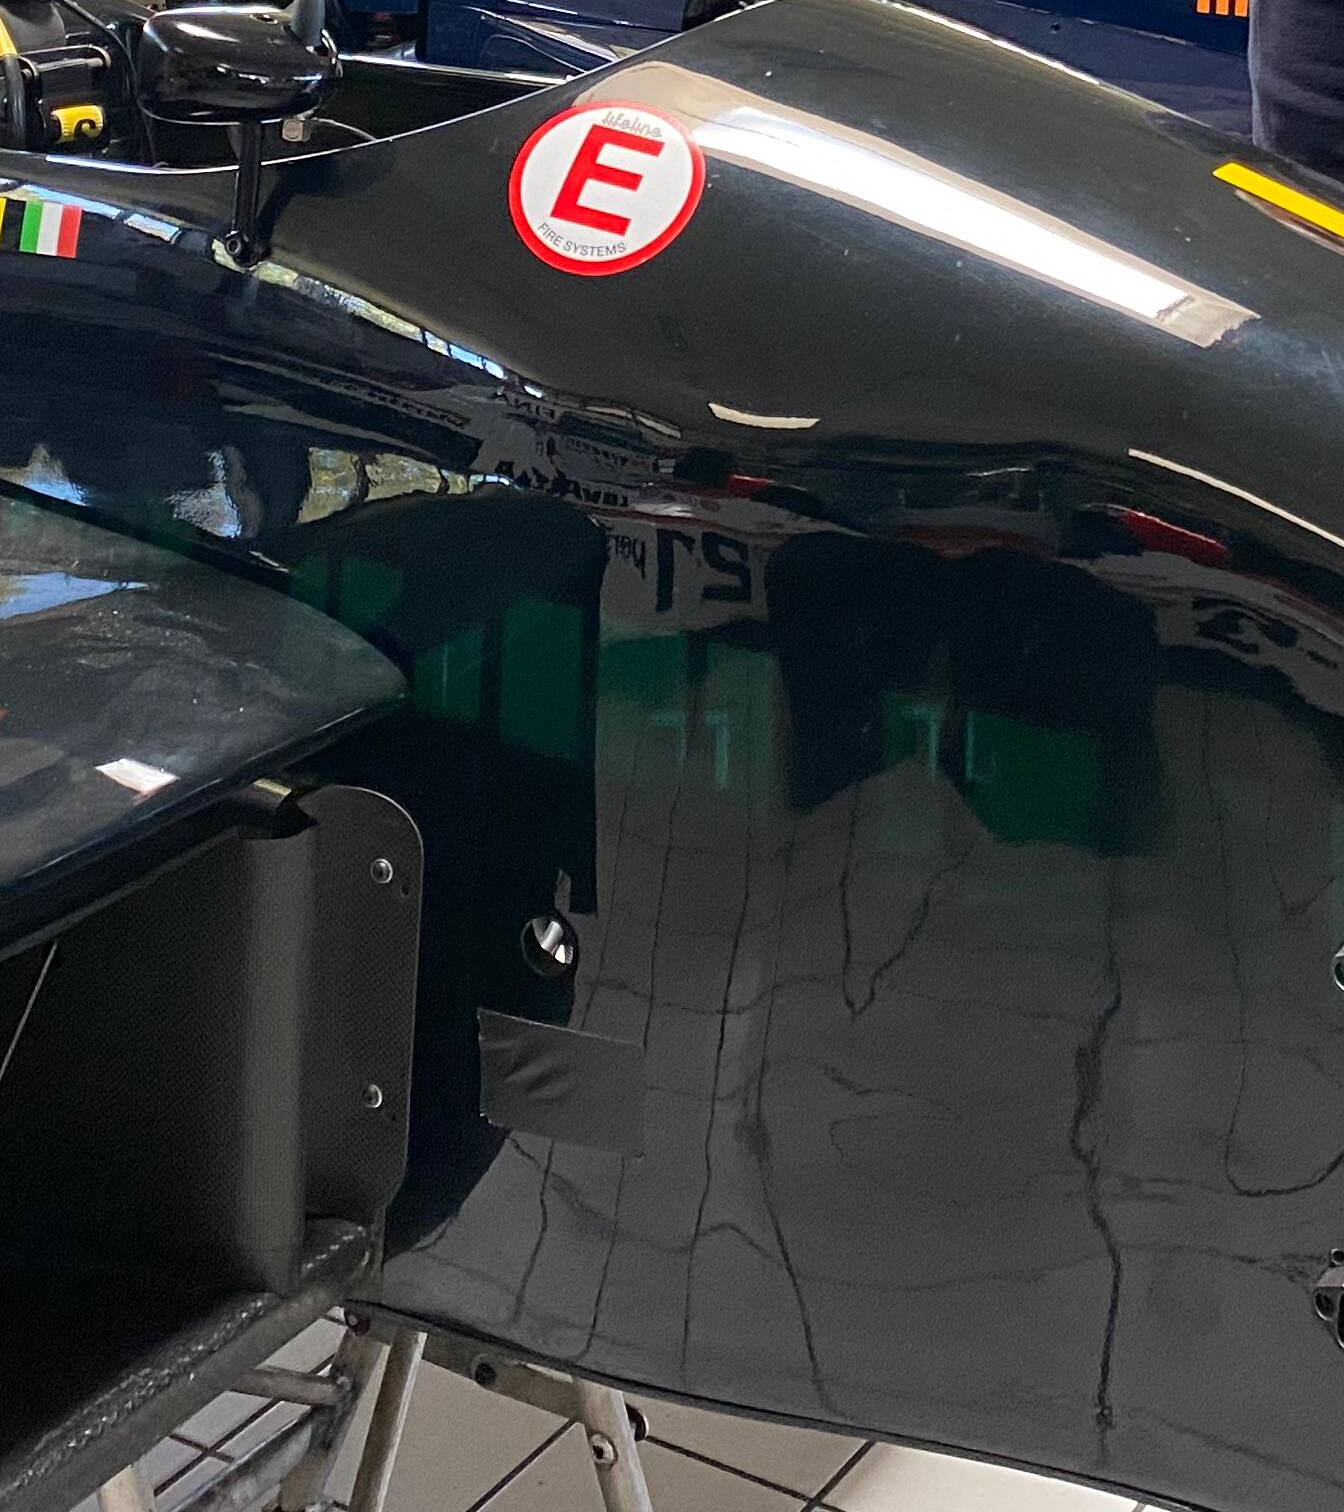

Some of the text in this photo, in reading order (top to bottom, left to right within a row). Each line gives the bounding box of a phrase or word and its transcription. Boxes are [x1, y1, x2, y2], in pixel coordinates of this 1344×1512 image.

[549, 123, 666, 237] E
[536, 222, 627, 258] FIRE SYSTEMS
